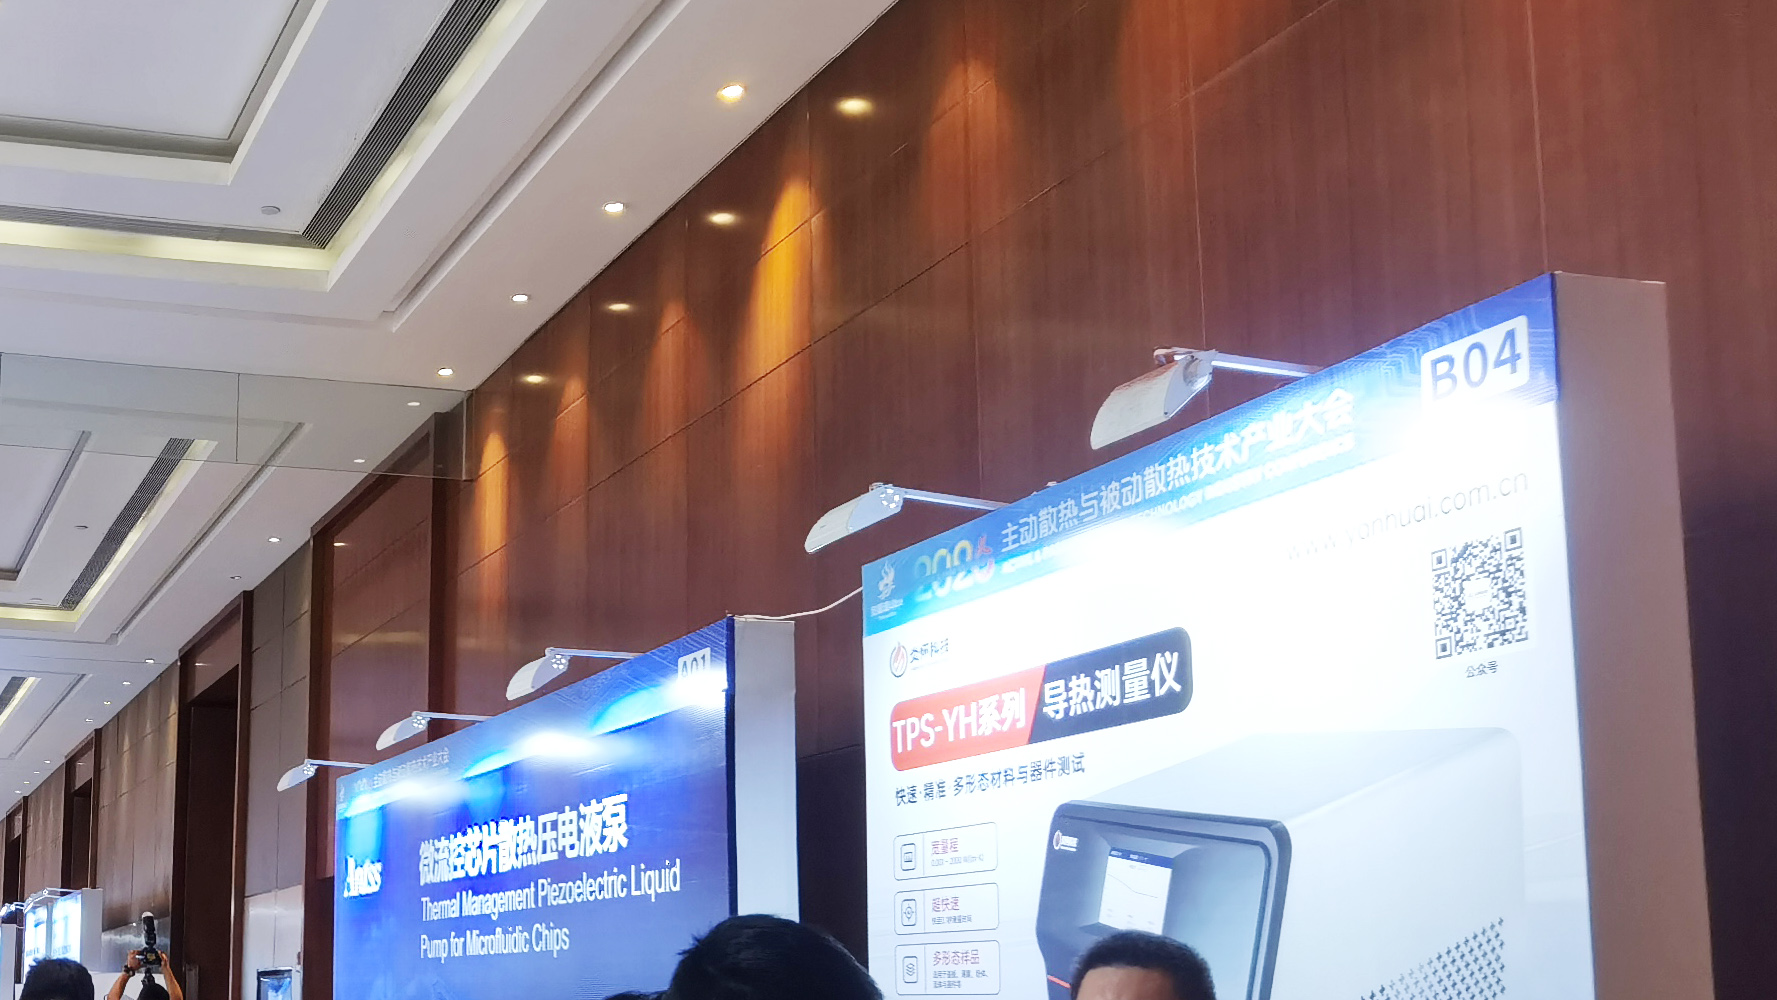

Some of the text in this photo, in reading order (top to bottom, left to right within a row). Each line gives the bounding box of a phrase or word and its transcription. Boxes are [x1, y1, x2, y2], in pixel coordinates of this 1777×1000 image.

[1431, 327, 1522, 400] B04
[1001, 387, 1355, 552] 主动散热与被动散热技术产业大会
[1042, 650, 1183, 720] 导热测量仪
[1465, 660, 1498, 678] 公众号
[892, 687, 1026, 754] TPS-YH系列
[419, 793, 629, 887] 微流控芯片散热压电液泵
[421, 857, 681, 922] Thermal Management Piezoelectric Liquid
[420, 921, 570, 964] Pump for Microfluidic Chips
[932, 948, 981, 967] 多形态样品
